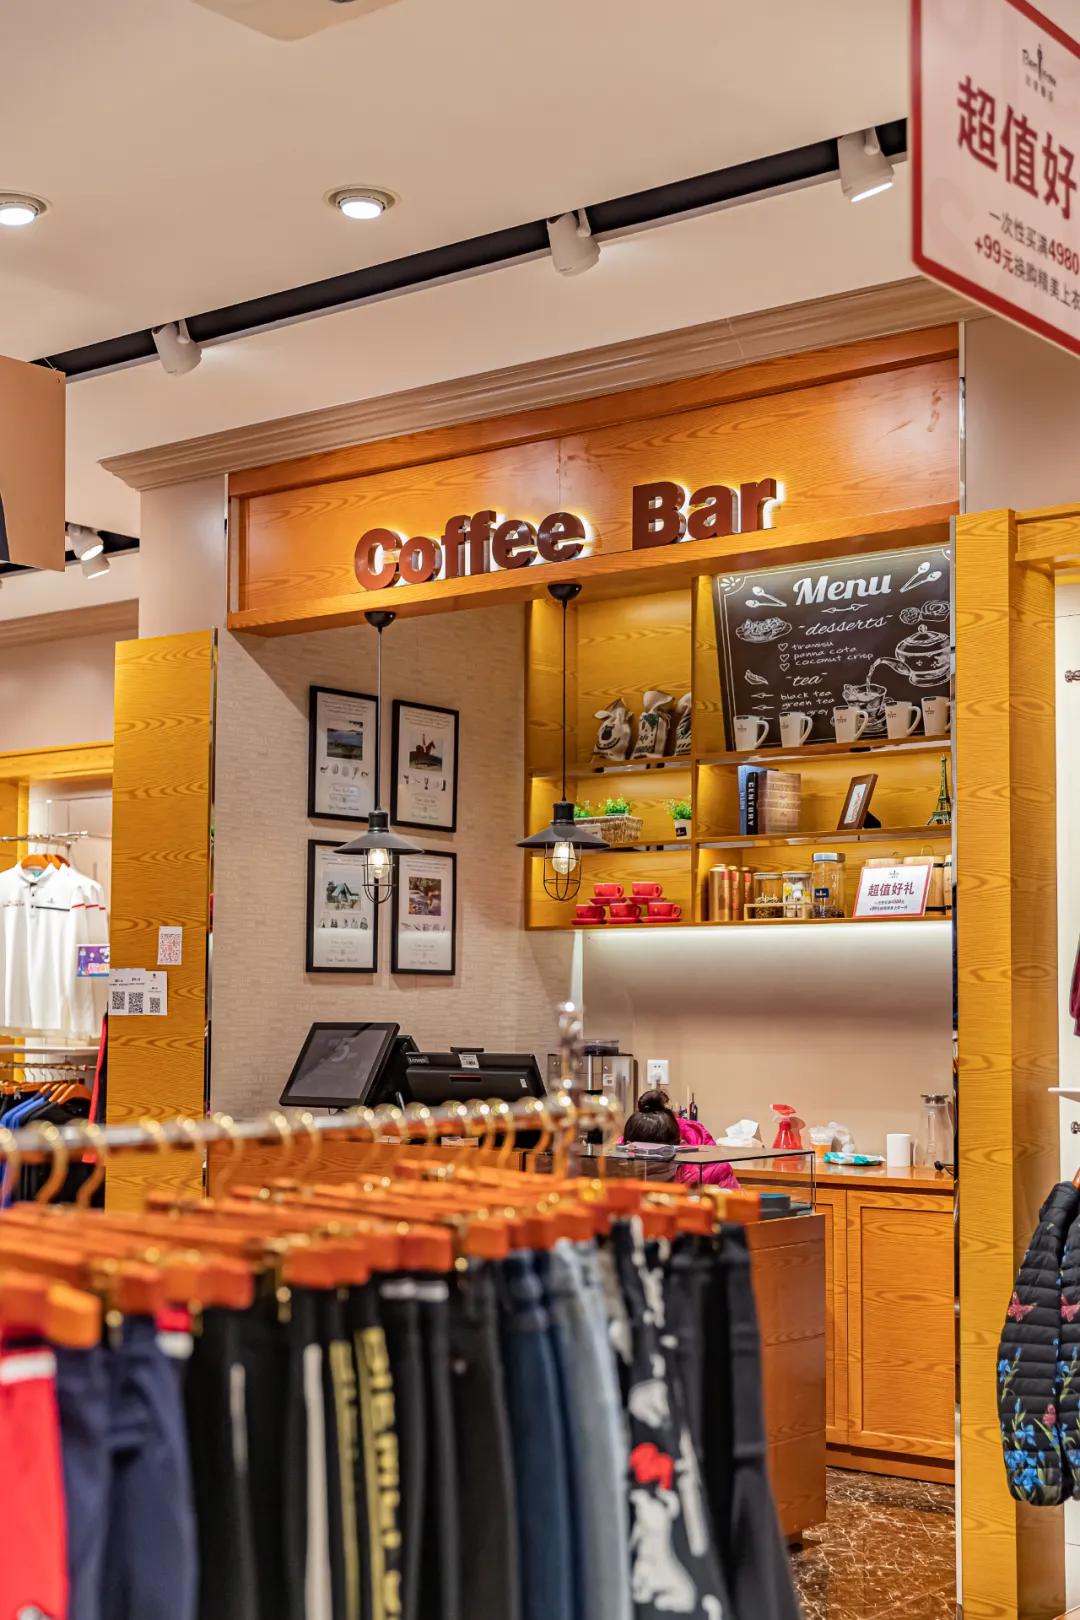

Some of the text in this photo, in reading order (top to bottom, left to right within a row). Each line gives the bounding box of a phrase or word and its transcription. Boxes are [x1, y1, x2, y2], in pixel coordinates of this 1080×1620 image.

[957, 75, 1077, 220] 超值好
[354, 478, 778, 590] Coffee Bar
[793, 574, 892, 606] Menu
[780, 692, 809, 701] black
[781, 700, 812, 710] green
[867, 881, 915, 897] 超值好礼
